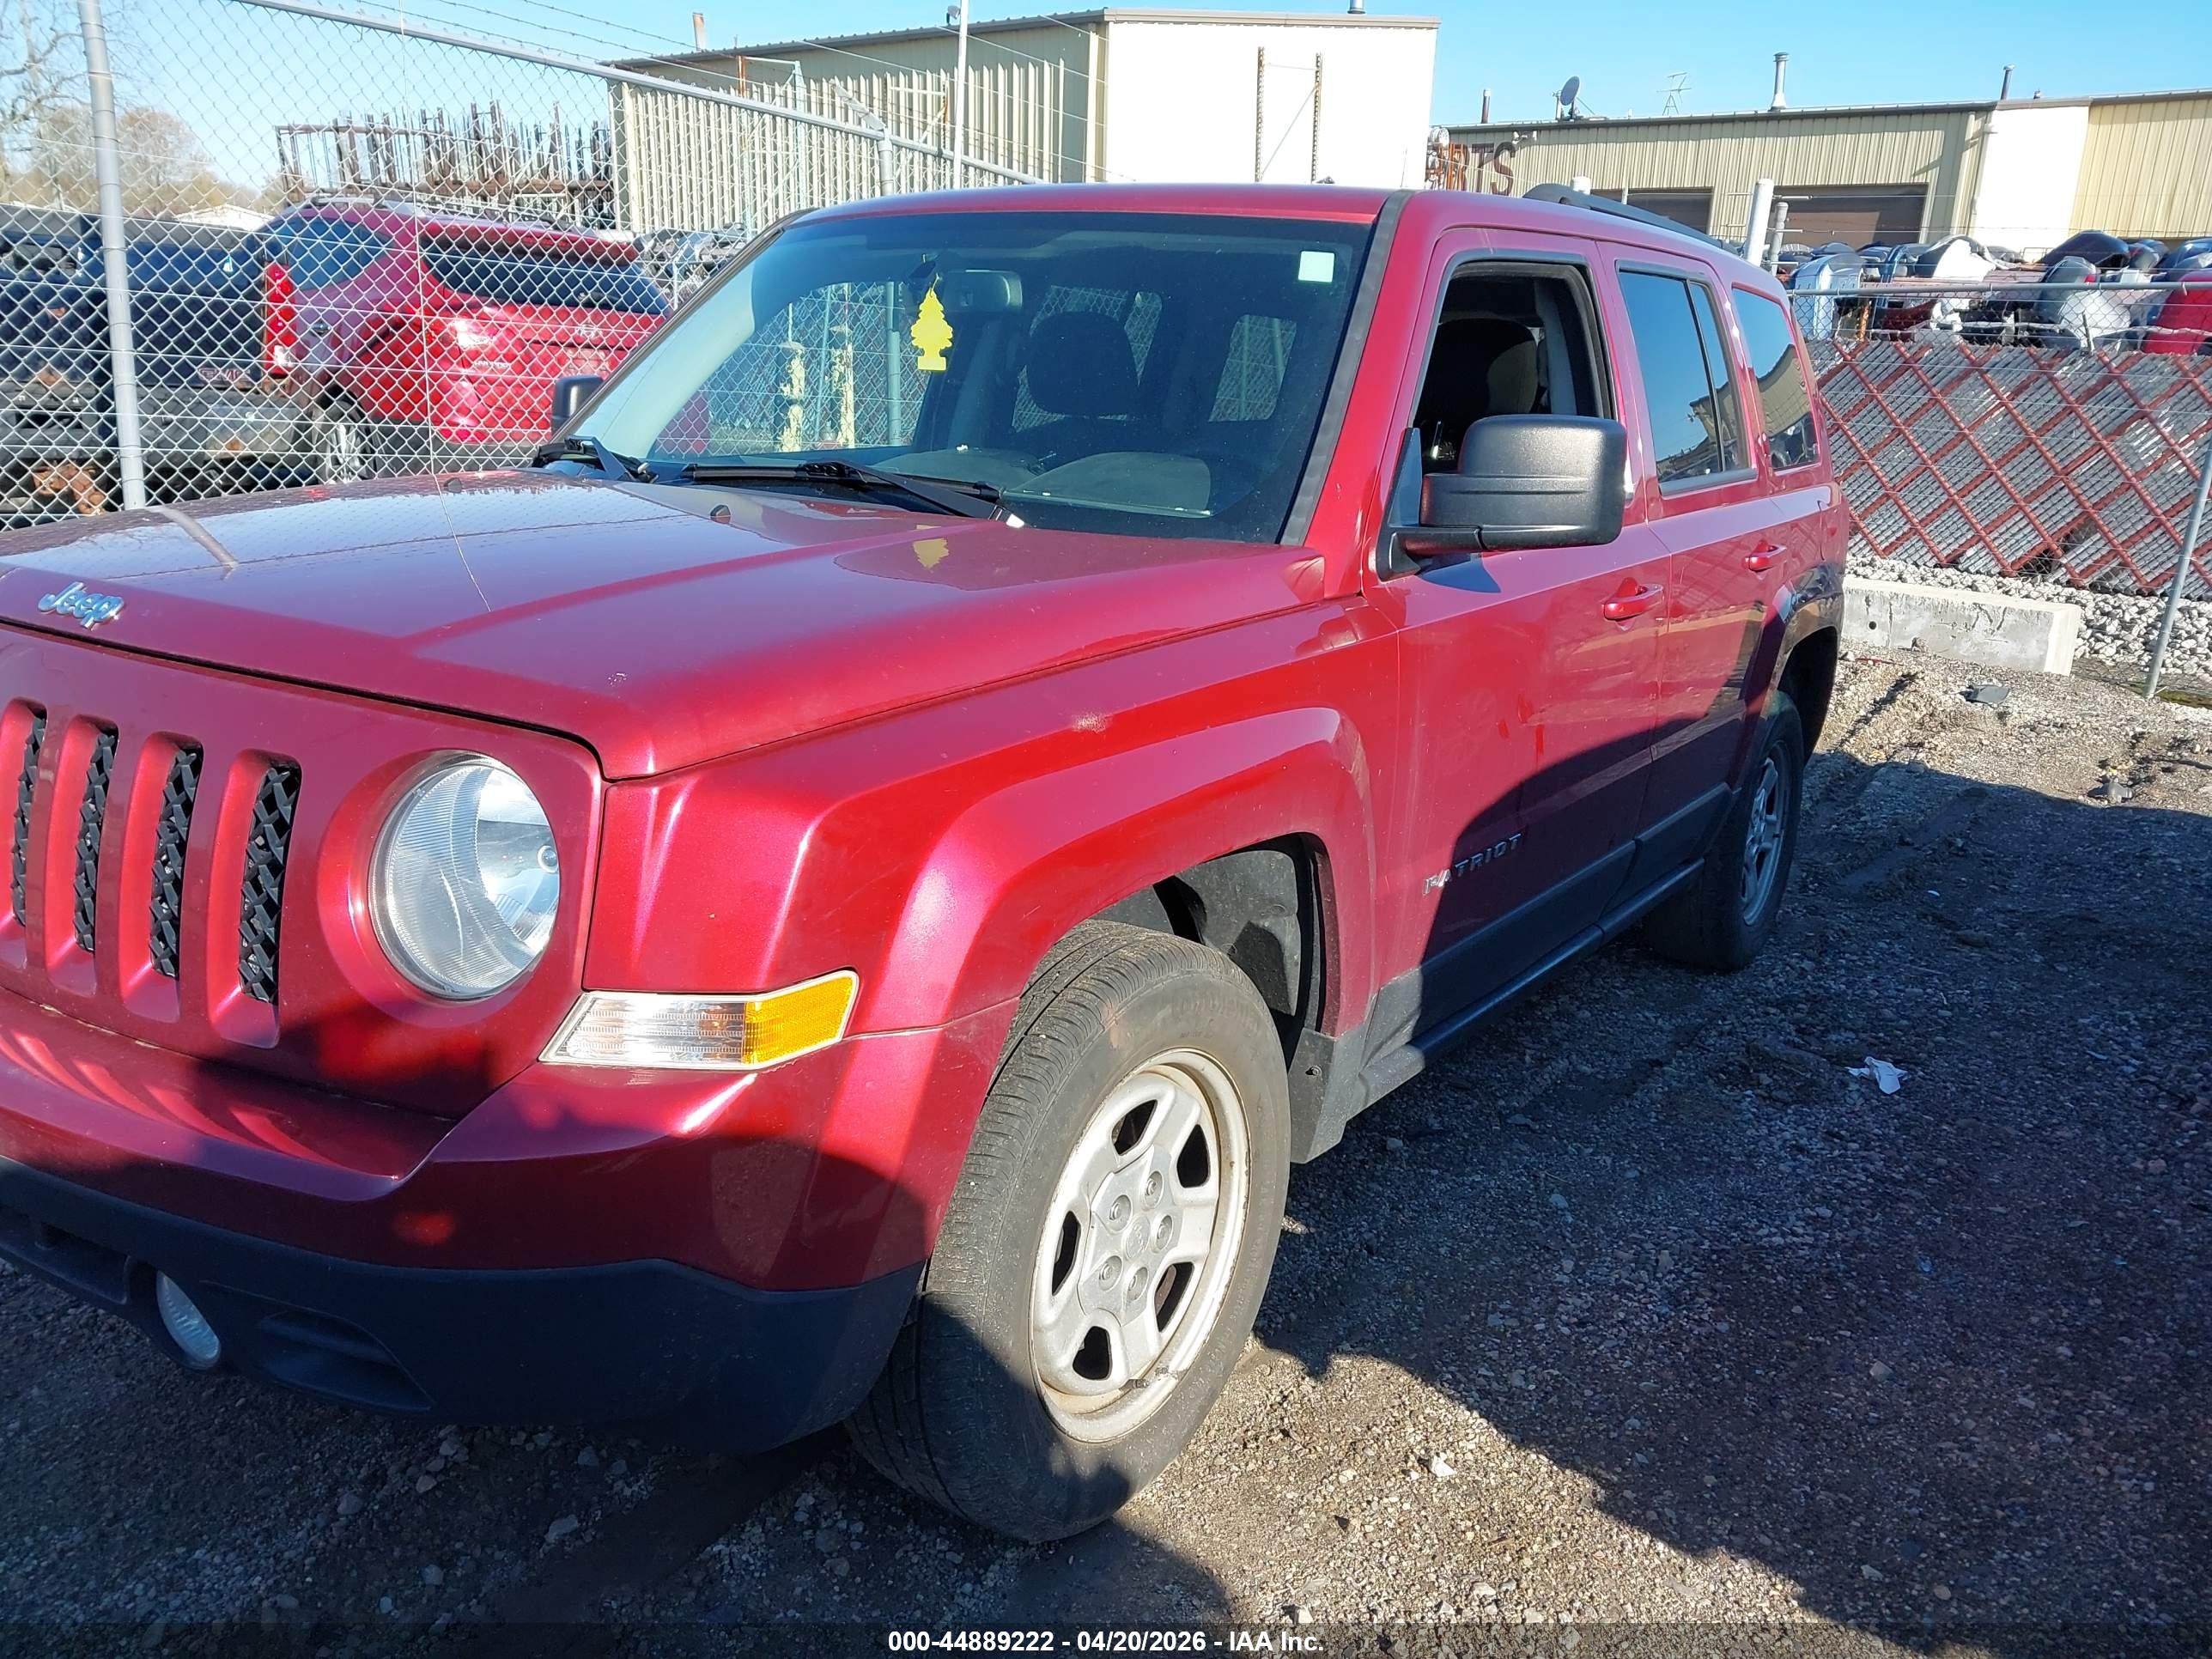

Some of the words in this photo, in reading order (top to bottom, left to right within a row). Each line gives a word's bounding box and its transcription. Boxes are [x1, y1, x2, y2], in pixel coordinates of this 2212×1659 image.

[1446, 141, 1516, 197] RTS
[37, 581, 125, 630] Jeep
[1423, 832, 1522, 896] PATRIOT
